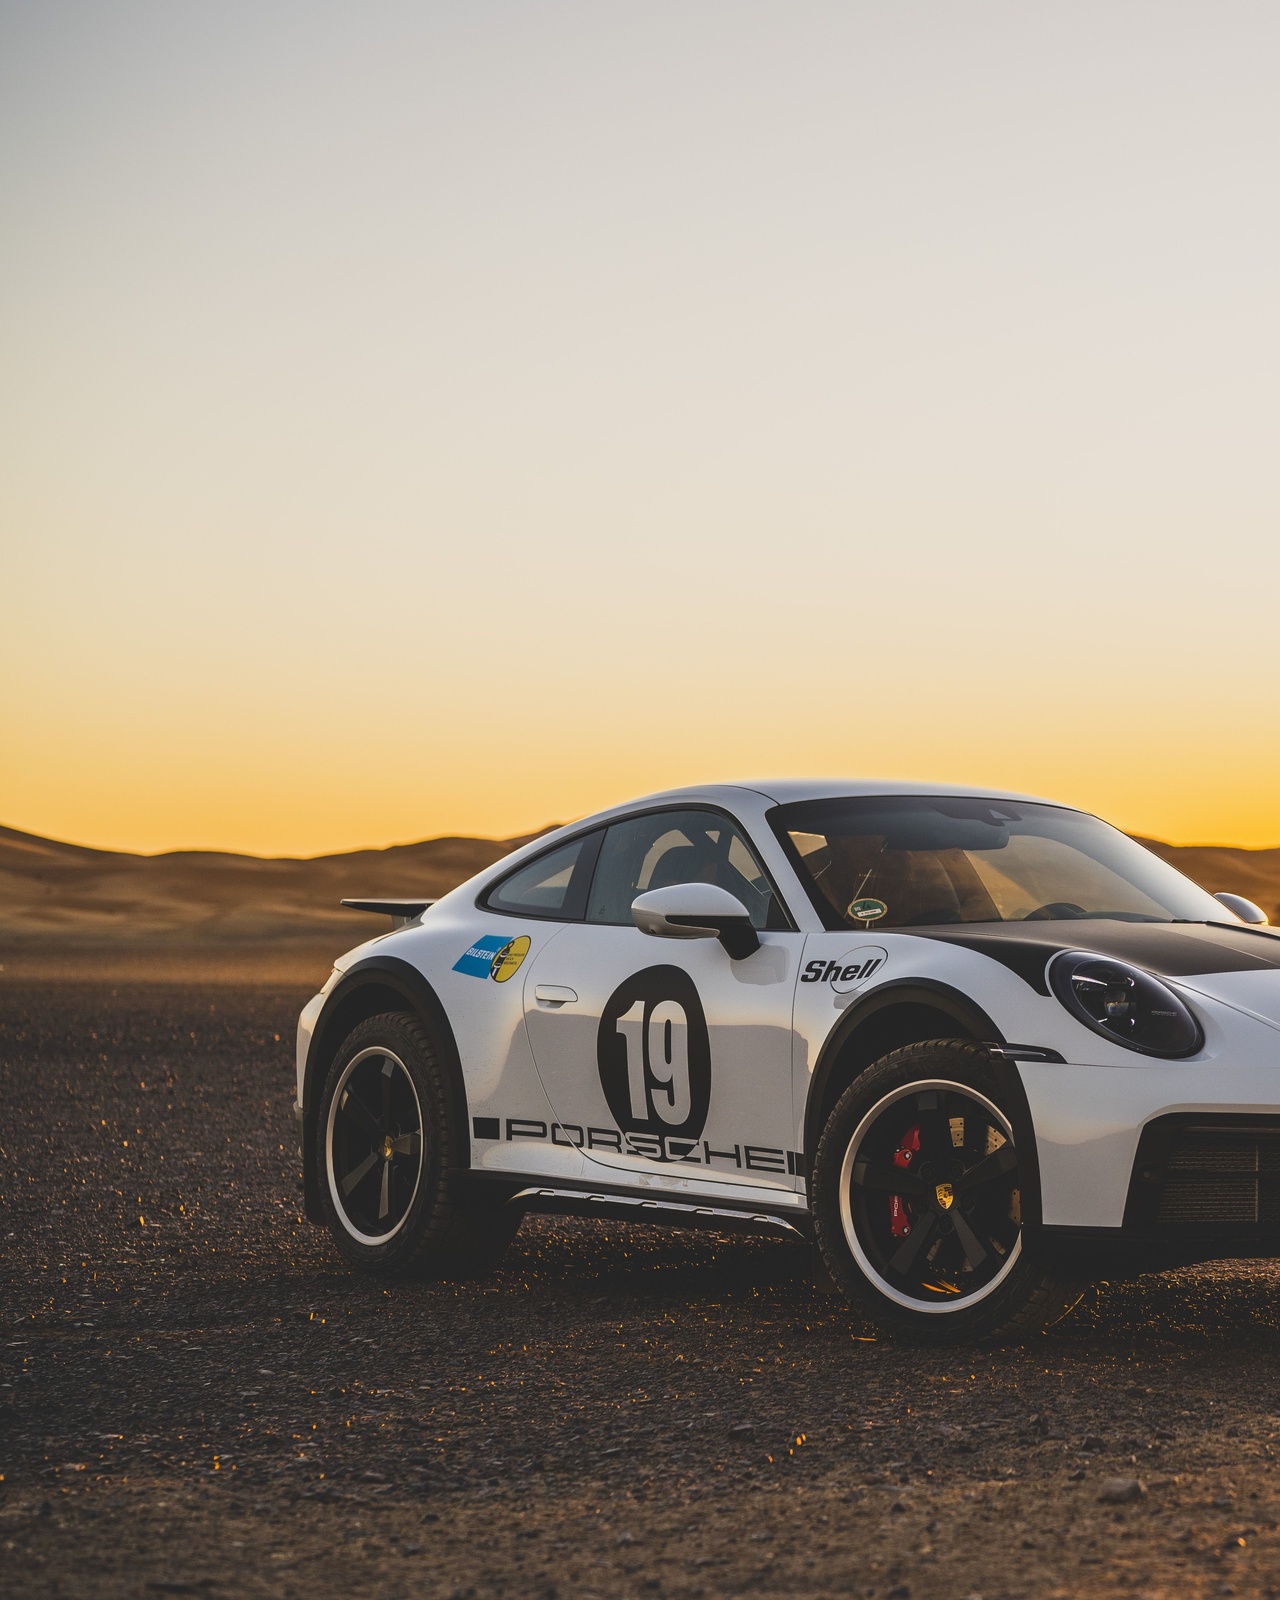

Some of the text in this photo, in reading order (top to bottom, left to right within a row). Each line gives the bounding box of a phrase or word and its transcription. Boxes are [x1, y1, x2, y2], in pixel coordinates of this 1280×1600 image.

[465, 947, 496, 960] BILSTEIN
[801, 959, 882, 982] Shell
[616, 1000, 691, 1125] 19
[505, 1118, 786, 1174] PORSCHE
